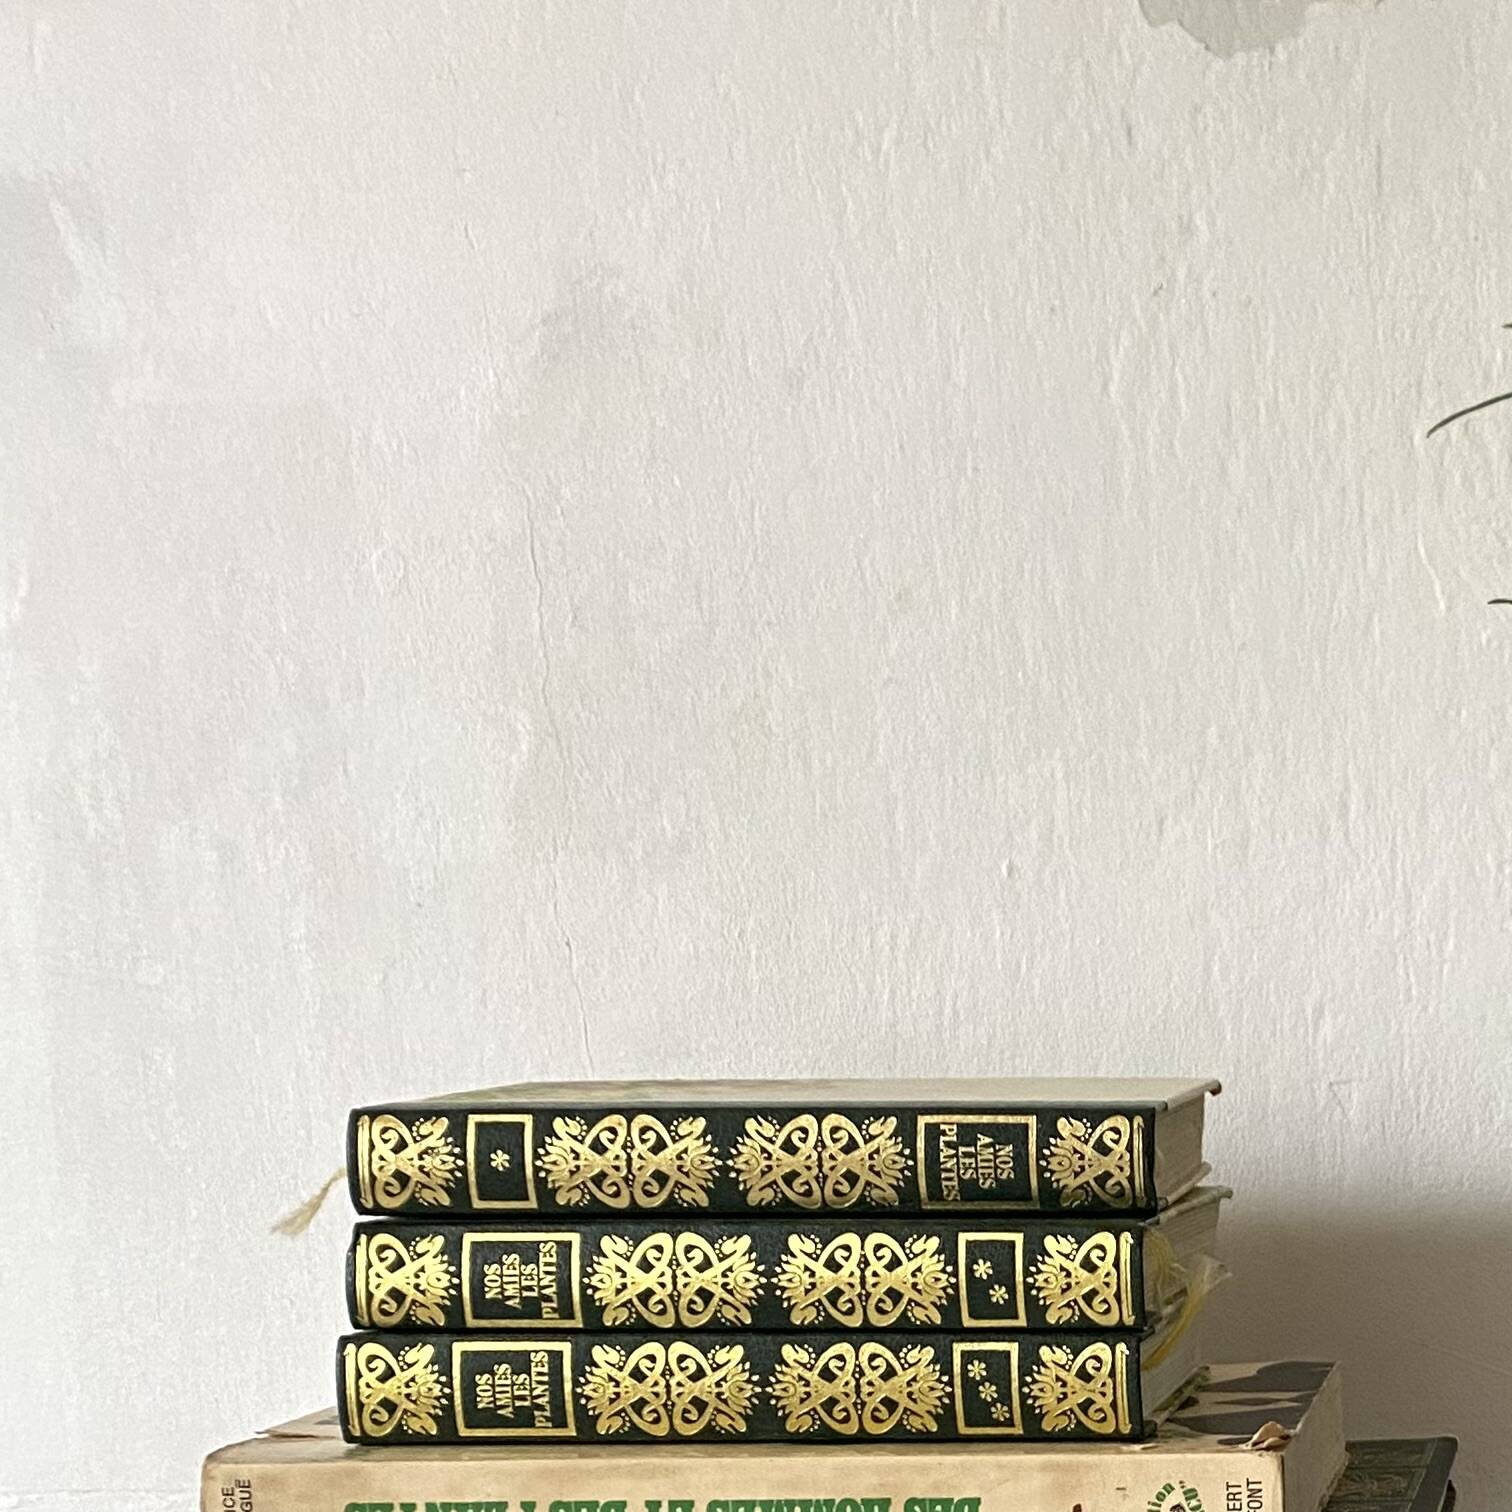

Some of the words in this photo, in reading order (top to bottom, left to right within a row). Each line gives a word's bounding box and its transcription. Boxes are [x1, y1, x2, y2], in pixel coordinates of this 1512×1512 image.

[940, 1123, 960, 1200] PLANTES
[958, 1146, 977, 1180] LES
[977, 1133, 996, 1189] AMIES
[995, 1144, 1014, 1179] NOS
[483, 1263, 502, 1299] NOS
[502, 1253, 522, 1310] AMIES
[520, 1263, 539, 1297] LES
[539, 1241, 559, 1319] PLANTES
[475, 1373, 494, 1409] NOS
[493, 1363, 514, 1418] AMIES
[512, 1373, 531, 1407] LES
[530, 1351, 552, 1427] PLANTES
